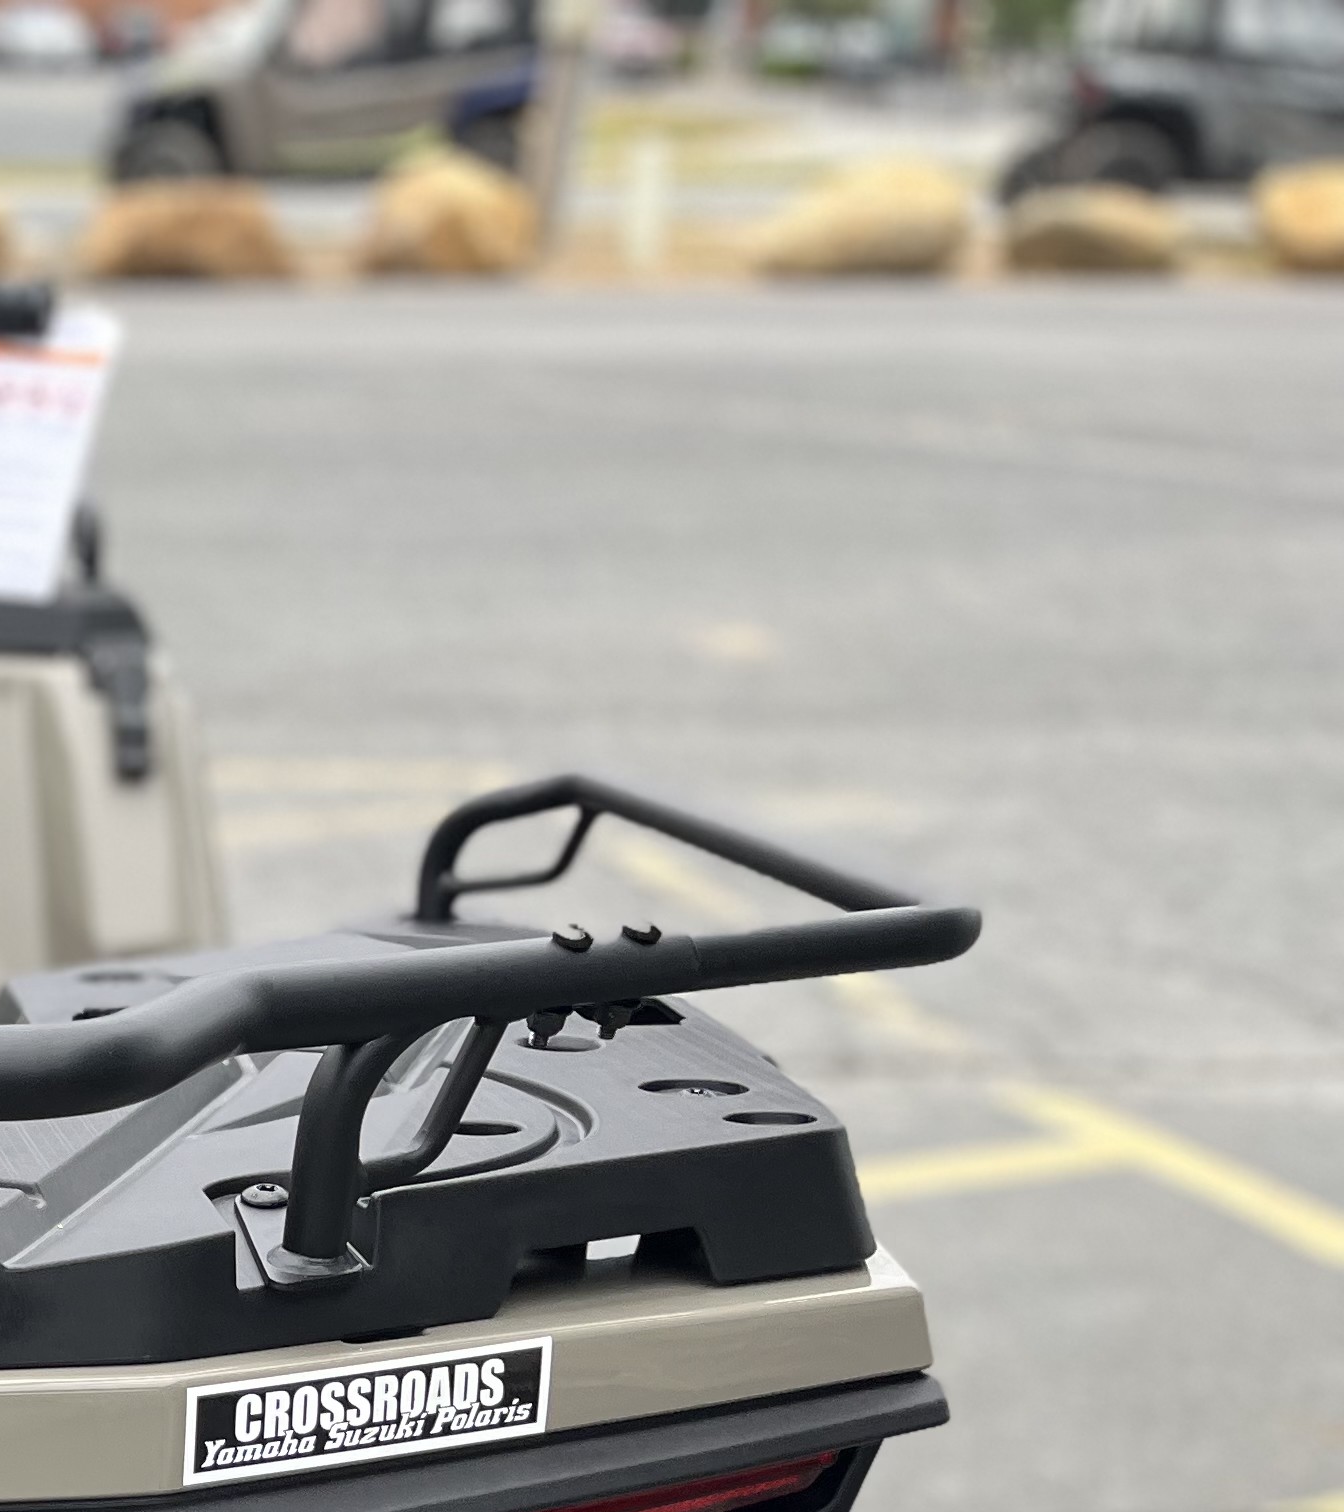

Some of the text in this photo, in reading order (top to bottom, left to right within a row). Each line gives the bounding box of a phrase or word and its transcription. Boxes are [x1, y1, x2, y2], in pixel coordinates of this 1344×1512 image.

[200, 1397, 534, 1470] Yamaha Suzuki Polaris
[233, 1358, 506, 1443] CROSSROADS
